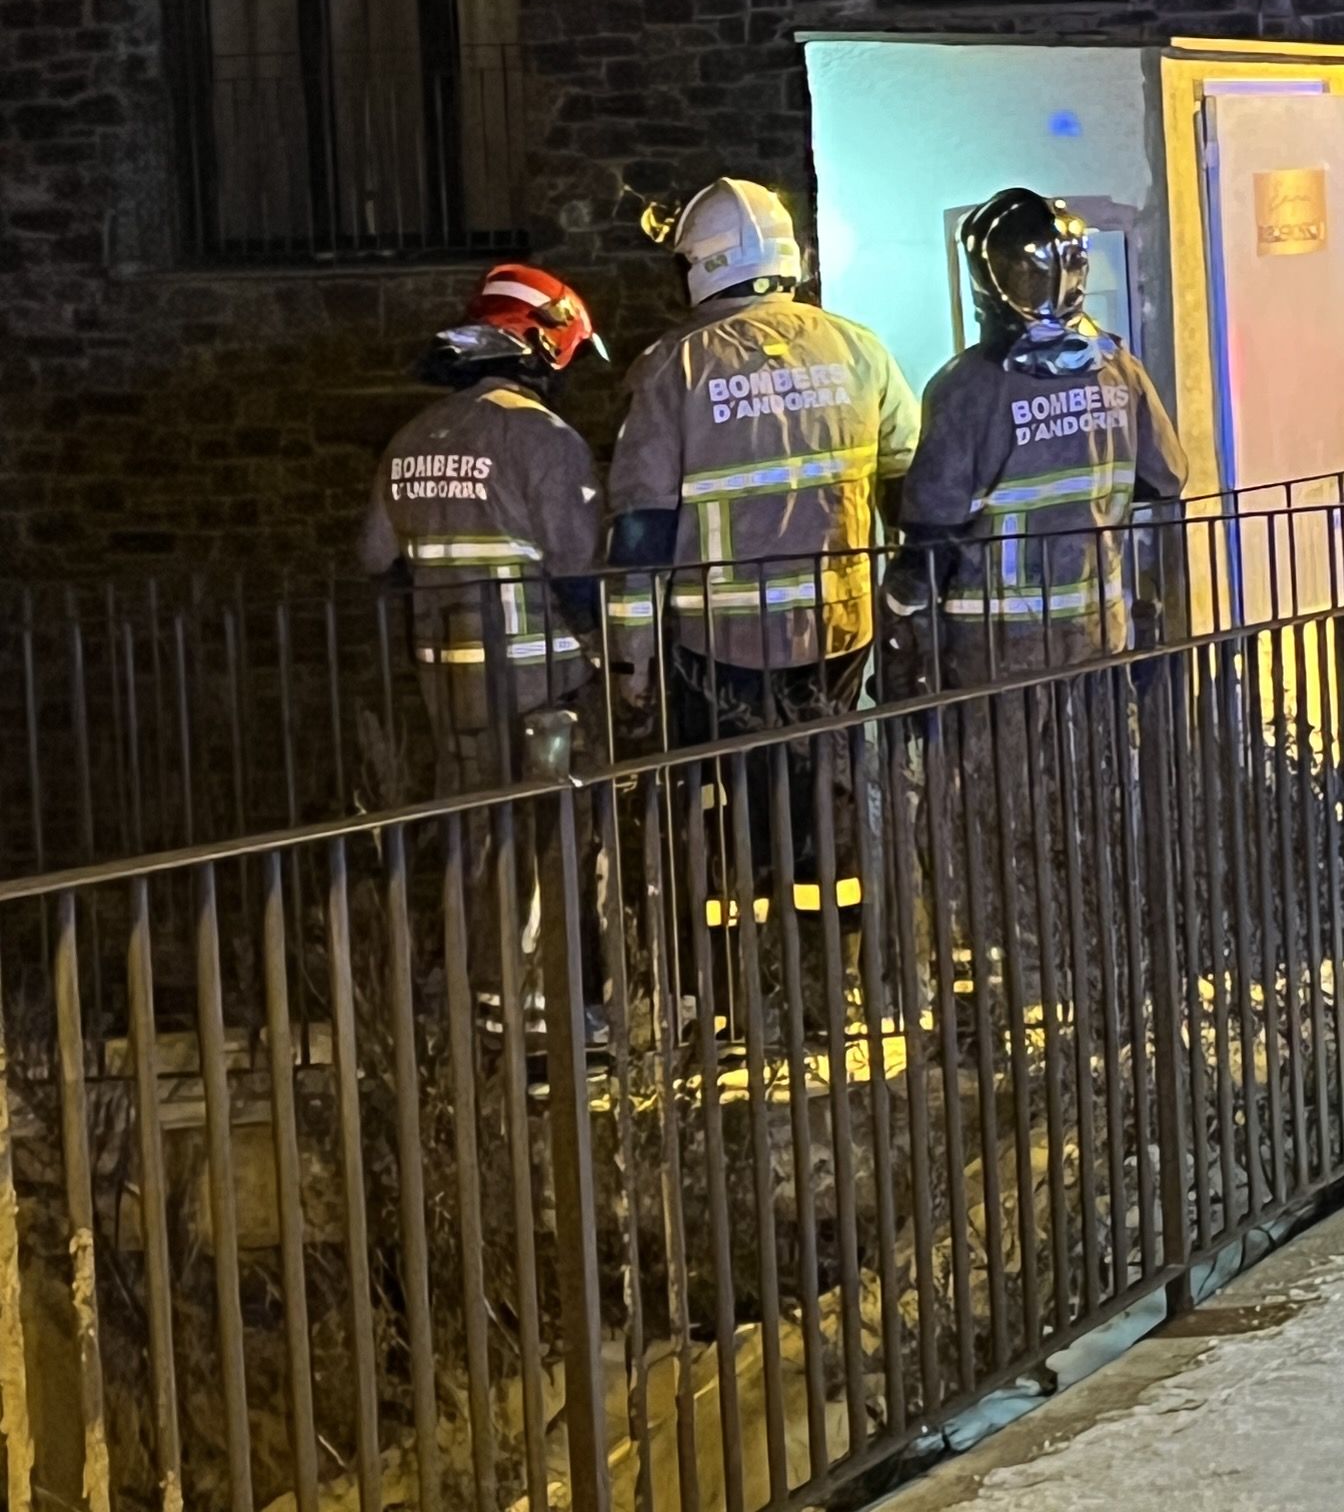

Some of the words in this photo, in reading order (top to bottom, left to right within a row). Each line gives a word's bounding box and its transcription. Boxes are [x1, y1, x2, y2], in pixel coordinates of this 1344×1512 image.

[709, 363, 848, 402] BOMBERS
[1011, 385, 1129, 425] BOMBERS
[391, 454, 493, 480] BOMBERS
